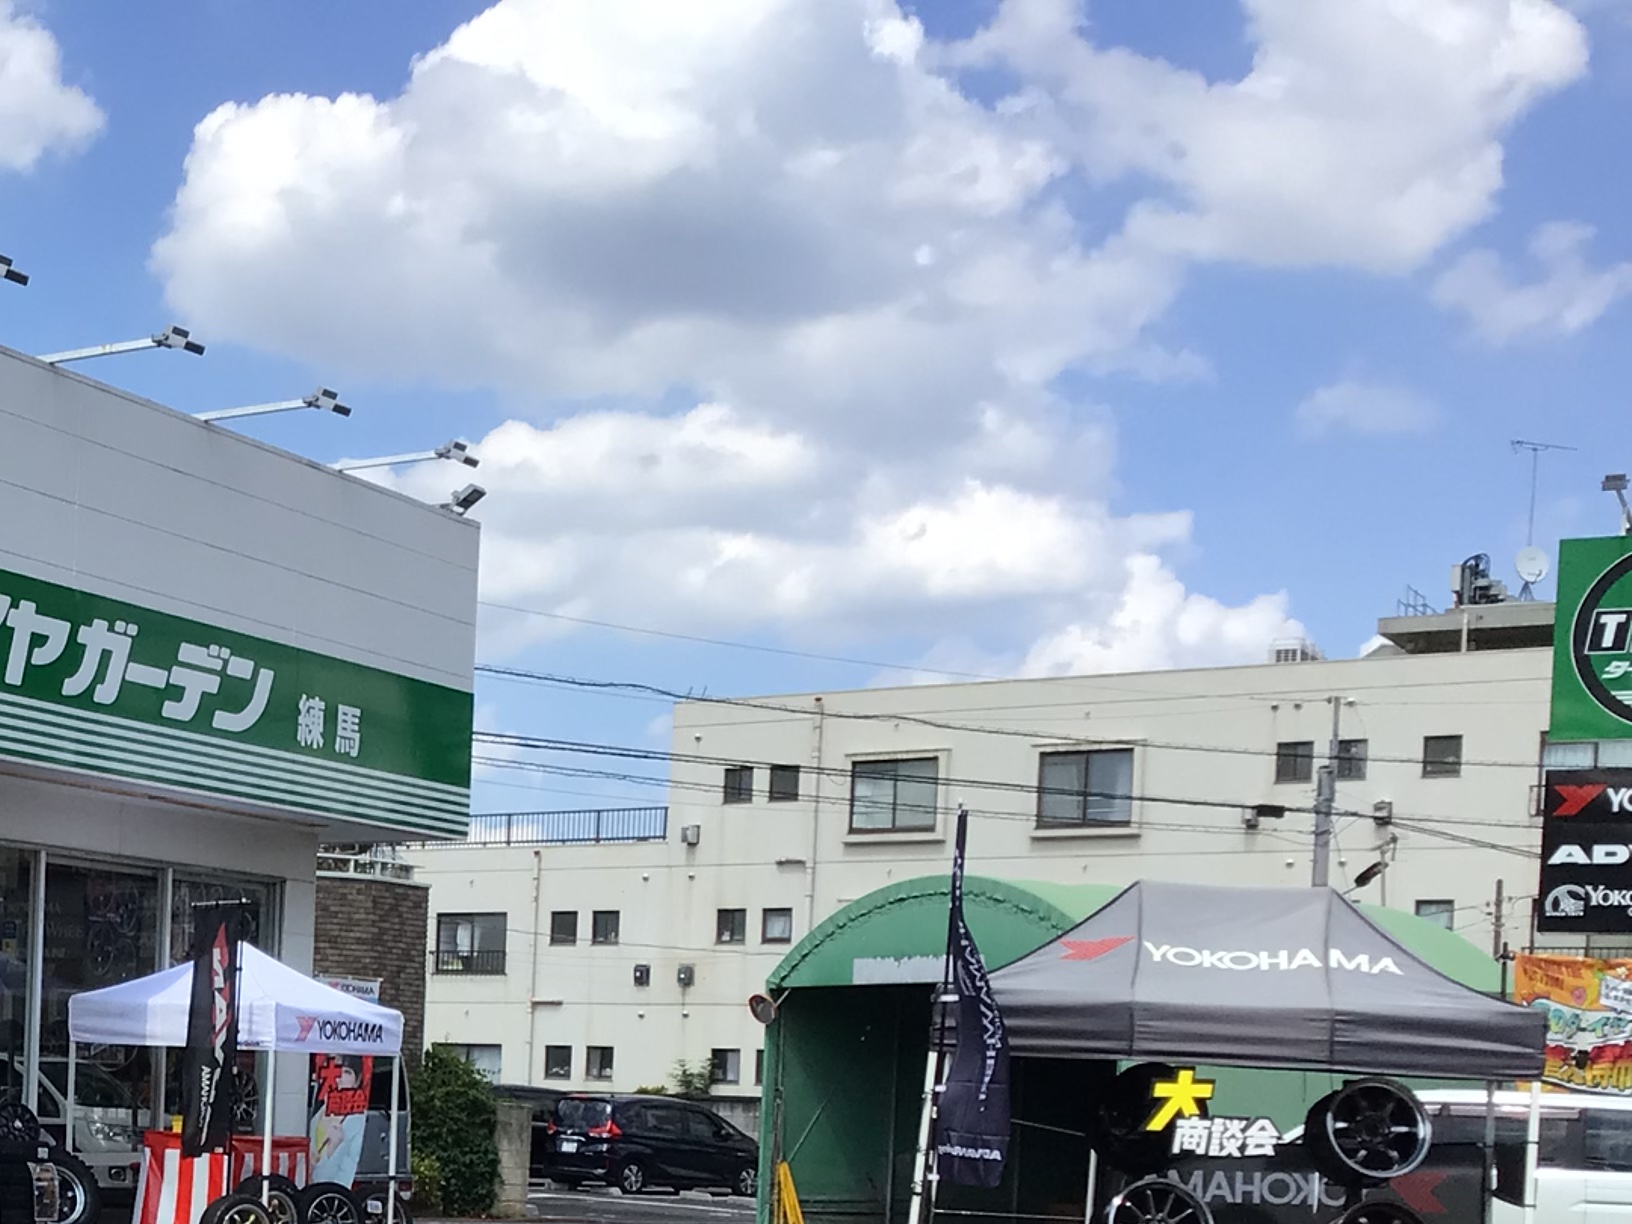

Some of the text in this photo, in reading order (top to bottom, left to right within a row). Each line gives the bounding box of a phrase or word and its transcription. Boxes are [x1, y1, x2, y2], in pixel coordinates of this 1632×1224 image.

[296, 692, 363, 758] 練馬
[1546, 844, 1632, 865] AD
[1143, 940, 1405, 975] YOKOHAMA
[317, 1020, 384, 1043] YOKOHAMA
[1146, 1070, 1280, 1158] 大 商談会
